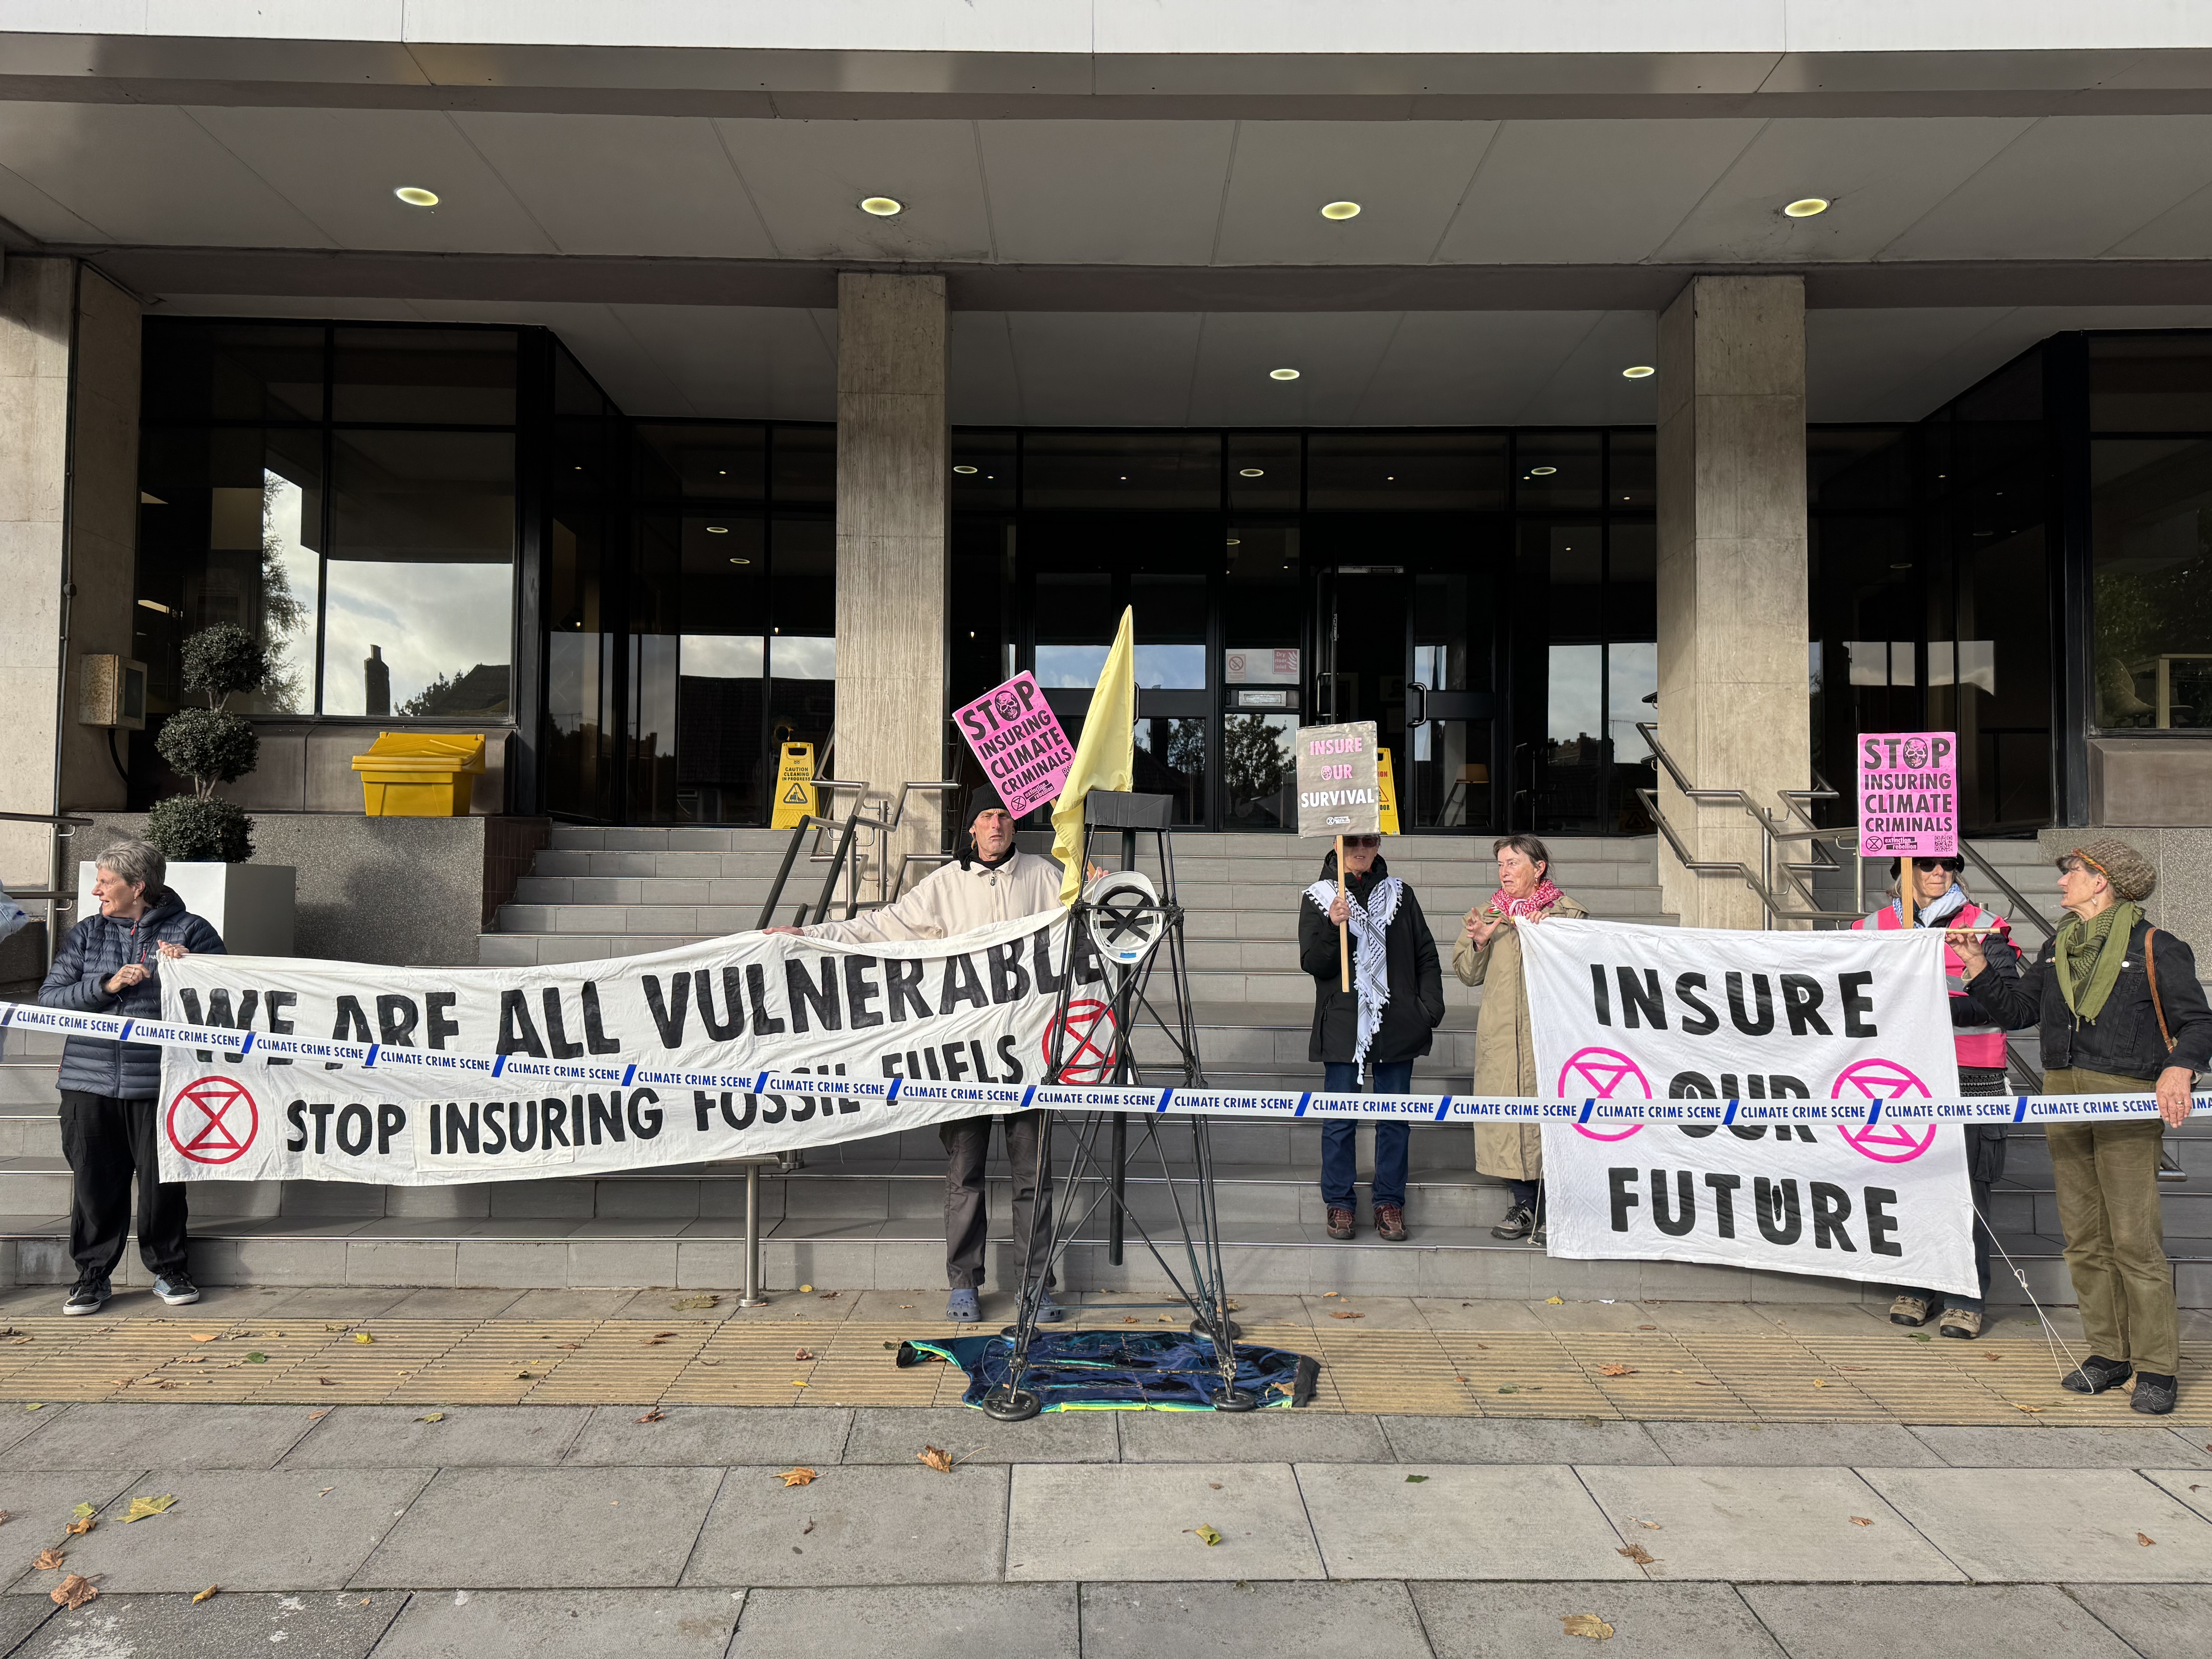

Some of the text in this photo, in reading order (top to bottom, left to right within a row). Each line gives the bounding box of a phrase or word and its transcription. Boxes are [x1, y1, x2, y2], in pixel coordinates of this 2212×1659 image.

[962, 680, 1034, 740] STOP
[978, 710, 1051, 760] INSURING
[991, 726, 1063, 778] CLIMATE
[1310, 737, 1362, 756] INSURE
[1864, 737, 1951, 770] STOP
[1001, 747, 1072, 795] CRIMINALS
[1321, 764, 1353, 780] OUR
[1025, 783, 1046, 797] extinction
[1865, 773, 1951, 790] INSURING
[1034, 786, 1054, 800] rebellion
[1301, 788, 1375, 808] SURVIVAL
[1865, 794, 1952, 814] CLIMATE
[1865, 817, 1953, 832] CRIMINALS
[180, 988, 297, 1065] WE
[495, 981, 620, 1059] ALL
[641, 908, 1104, 1049] VULNERABLE
[1590, 964, 1878, 1037] INSURE
[17, 1011, 118, 1033] CLIMATE CRIME SCENE
[136, 1025, 239, 1046] CLIMATE CRIME SCENE
[257, 1039, 363, 1059] CLIMATE CRIME SCENE
[381, 1051, 489, 1070] CLIMATE CRIME SCENE
[508, 1063, 619, 1080] CLIMATE CRIME SCENE
[638, 1072, 751, 1088] CLIMATE CRIME SCENE
[771, 1079, 884, 1095] CLIMATE CRIME SCENE
[903, 1086, 1018, 1101] CLIMATE CRIME SCENE
[1038, 1093, 1155, 1105] CLIMATE CRIME SCENE
[1175, 1096, 1293, 1109] CLIMATE CRIME SCENE
[1313, 1100, 1433, 1113] CLIMATE CRIME SCENE
[1669, 1071, 1818, 1143] OUR
[2032, 1100, 2158, 1115] CLIMATE CRIME SCENE
[1454, 1103, 1576, 1116] CLIMATE CRIME SCENE
[1597, 1106, 1721, 1118] CLIMATE CRIME SCENE
[1741, 1106, 1865, 1118] CLIMATE CRIME SCENE
[1886, 1104, 2010, 1117] CLIMATE CRIME SCENE
[287, 1099, 406, 1156] STOP
[430, 1087, 663, 1155] INSURING
[1608, 1167, 1902, 1257] FUTURE
